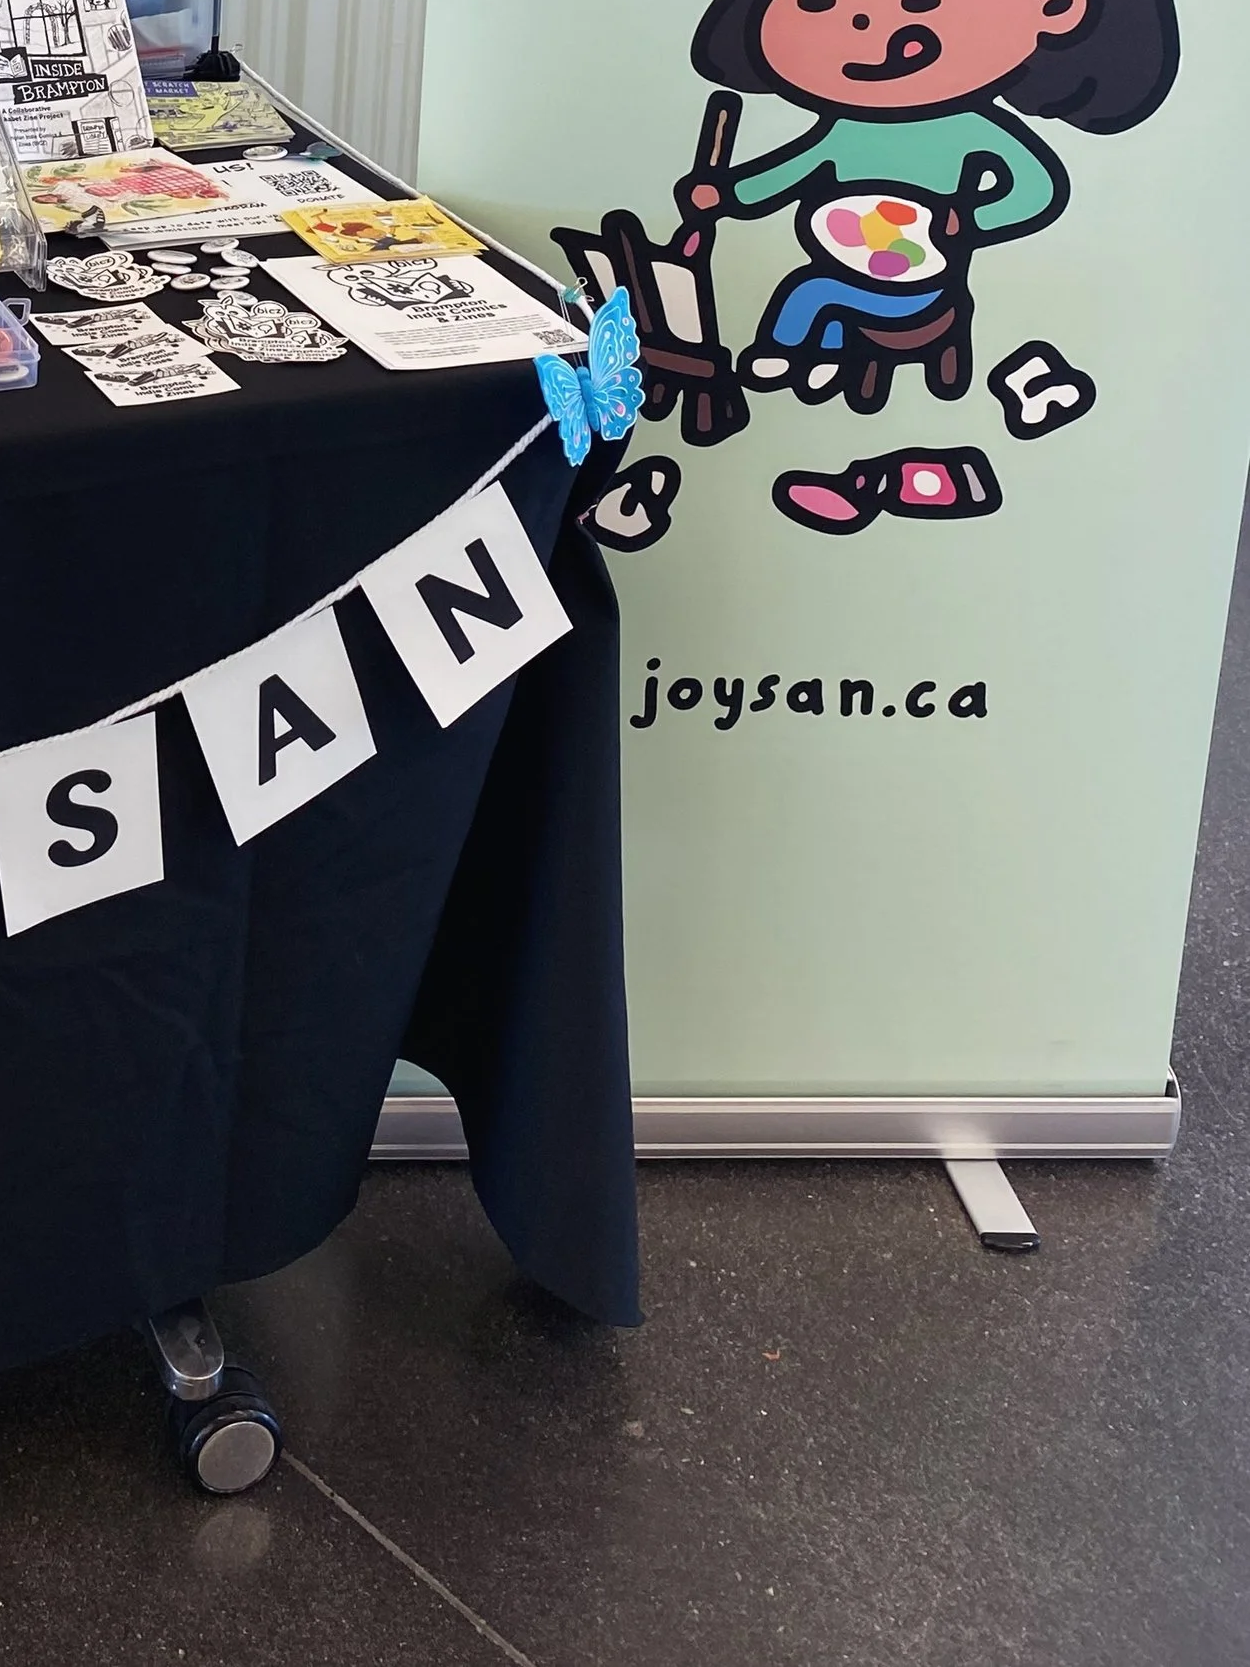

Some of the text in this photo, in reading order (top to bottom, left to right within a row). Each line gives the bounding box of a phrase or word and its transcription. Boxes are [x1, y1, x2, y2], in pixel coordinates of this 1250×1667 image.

[35, 63, 83, 78] INSIDE
[17, 78, 106, 102] BRAMPTON
[8, 105, 51, 114] Collaborative
[40, 112, 64, 121] Project
[297, 194, 346, 203] DONATE
[395, 256, 432, 268] bicz
[257, 306, 282, 315] bicz
[406, 302, 508, 321] Indie Comics
[411, 298, 490, 314] Brampton
[437, 311, 496, 324] & Zines
[139, 380, 192, 392] Brampton
[165, 383, 206, 393] Comics
[629, 657, 988, 730] joysan.ca
[46, 539, 525, 868] SAN
